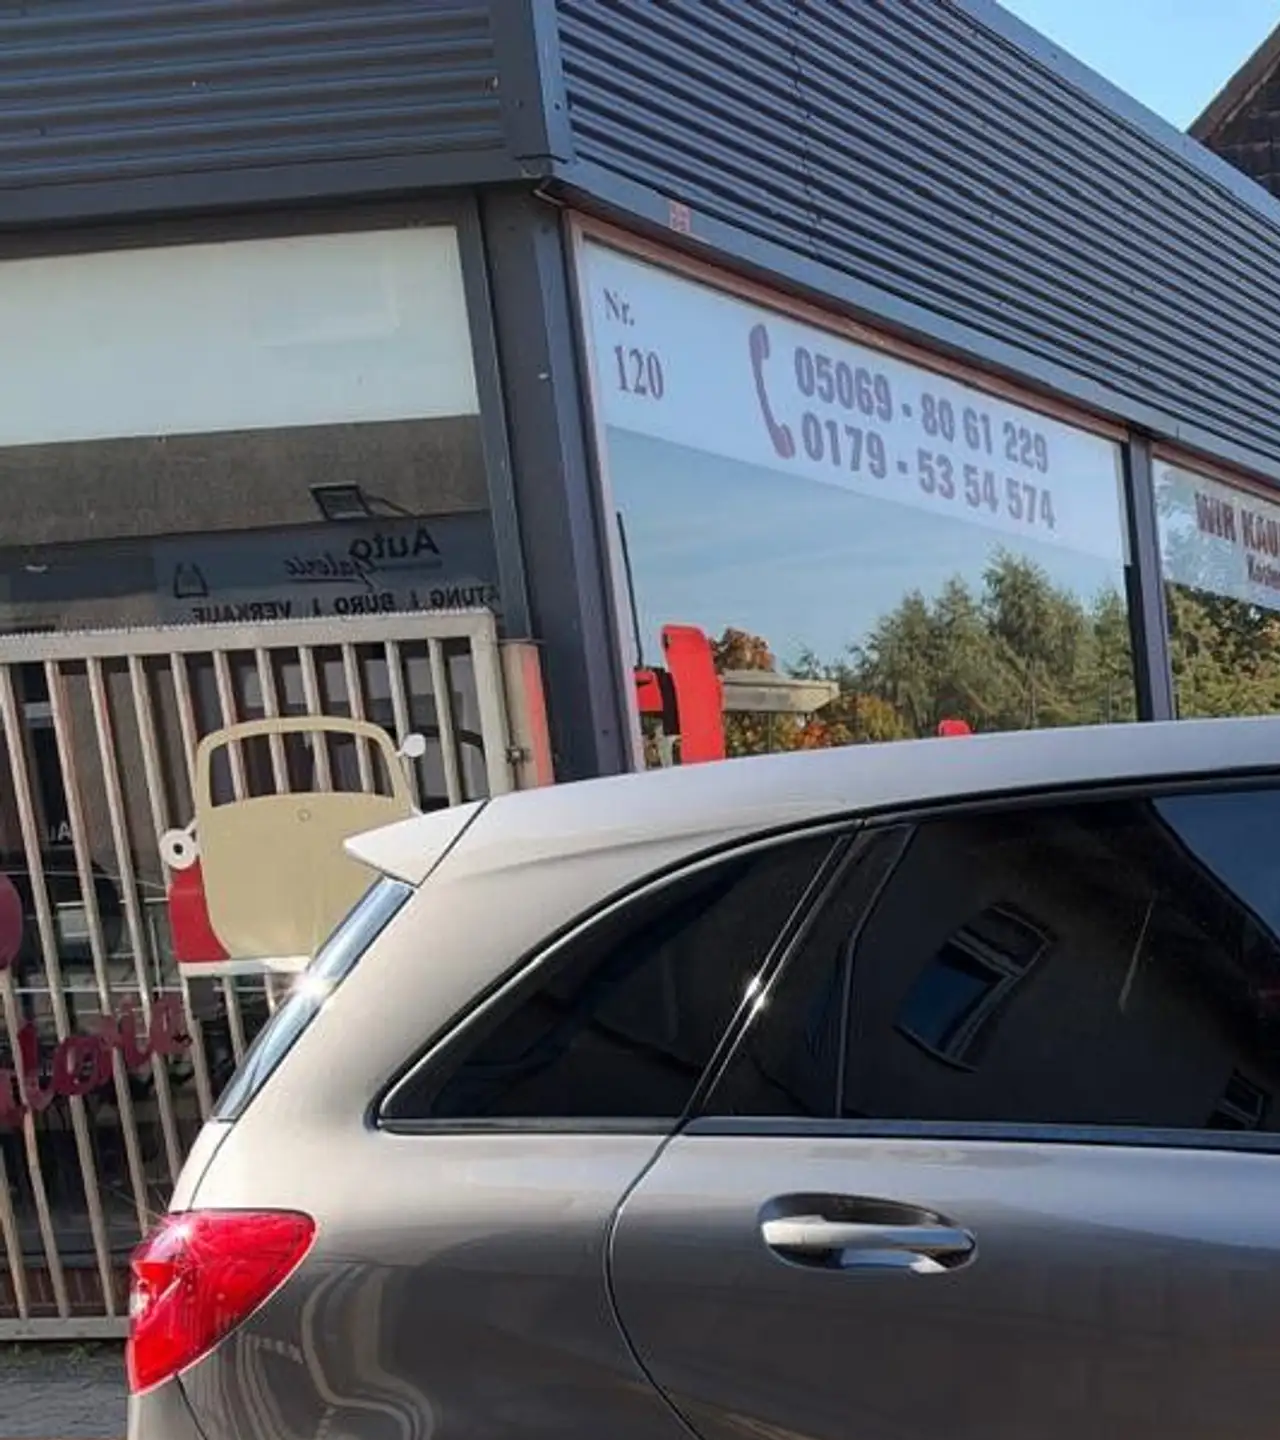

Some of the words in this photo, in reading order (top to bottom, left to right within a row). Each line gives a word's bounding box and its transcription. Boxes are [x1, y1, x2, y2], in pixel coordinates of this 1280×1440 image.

[603, 287, 635, 326] Nr.
[614, 345, 664, 401] 120
[794, 346, 893, 423] 05069
[920, 392, 956, 444] 80
[962, 406, 993, 456] 61
[1003, 420, 1049, 474] 229
[801, 410, 887, 480] 0179
[917, 446, 956, 500] 53
[963, 463, 999, 514] 54
[1006, 476, 1057, 530] 574
[1195, 490, 1237, 543] WIR
